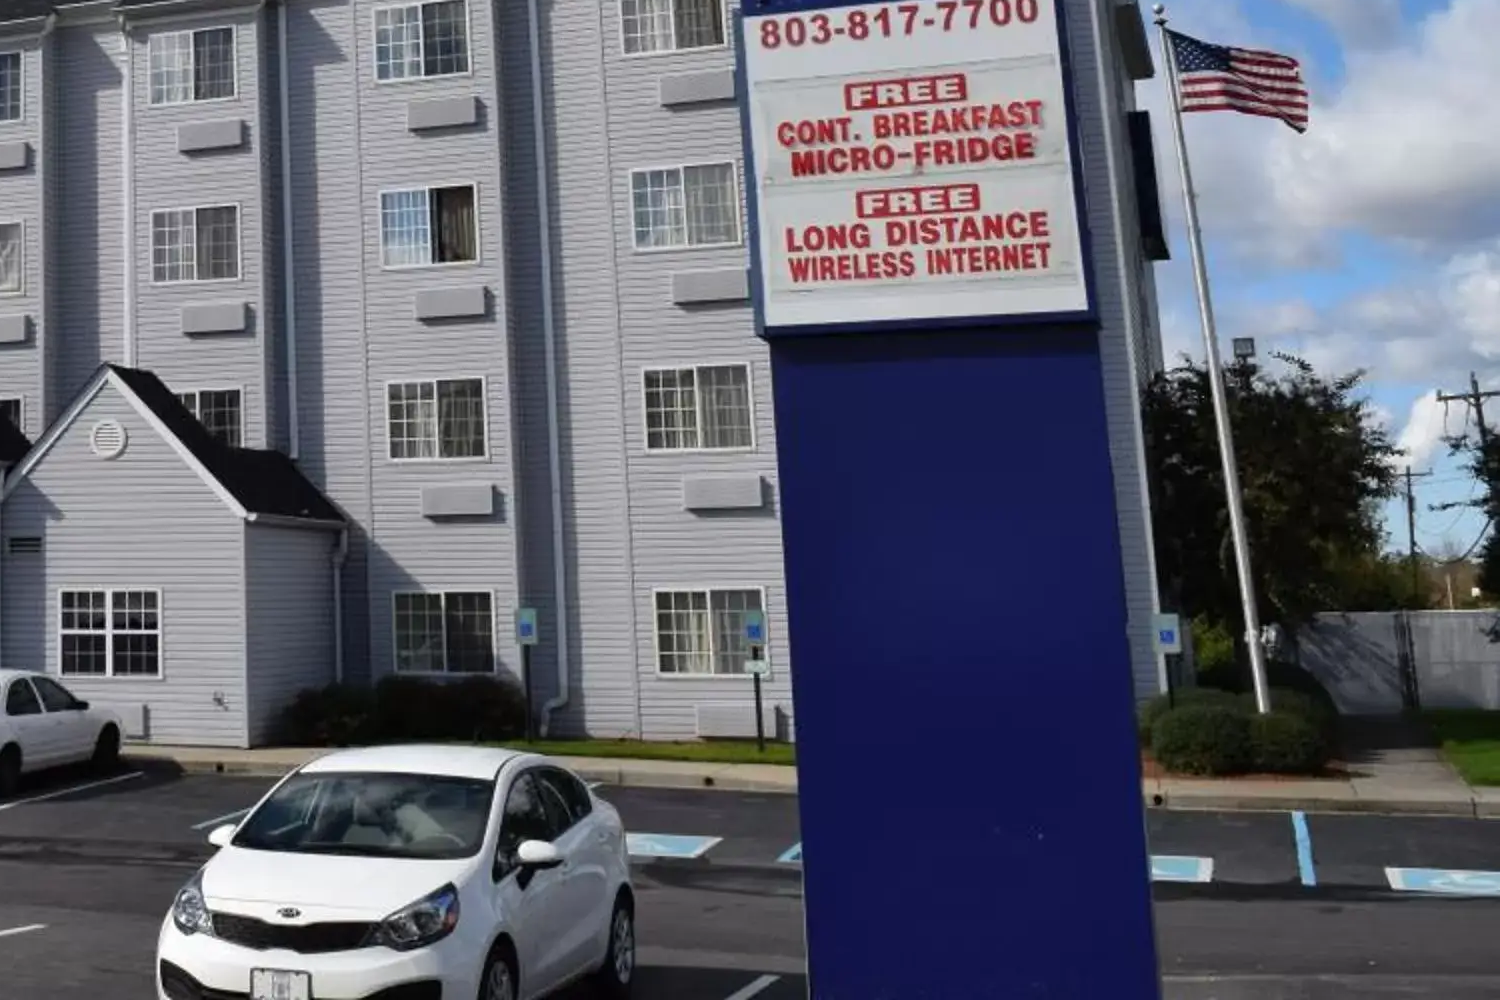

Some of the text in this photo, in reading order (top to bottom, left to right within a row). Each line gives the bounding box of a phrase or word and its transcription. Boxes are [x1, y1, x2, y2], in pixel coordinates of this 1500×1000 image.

[848, 76, 964, 109] FREE
[777, 100, 1043, 149] CONT. BREAKFAST
[790, 132, 1035, 177] MICRO-FRIDGE
[860, 186, 976, 217] FREE
[786, 211, 1050, 253] LONG DISTANCE
[788, 243, 1051, 282] WIRELESS INTERNET
